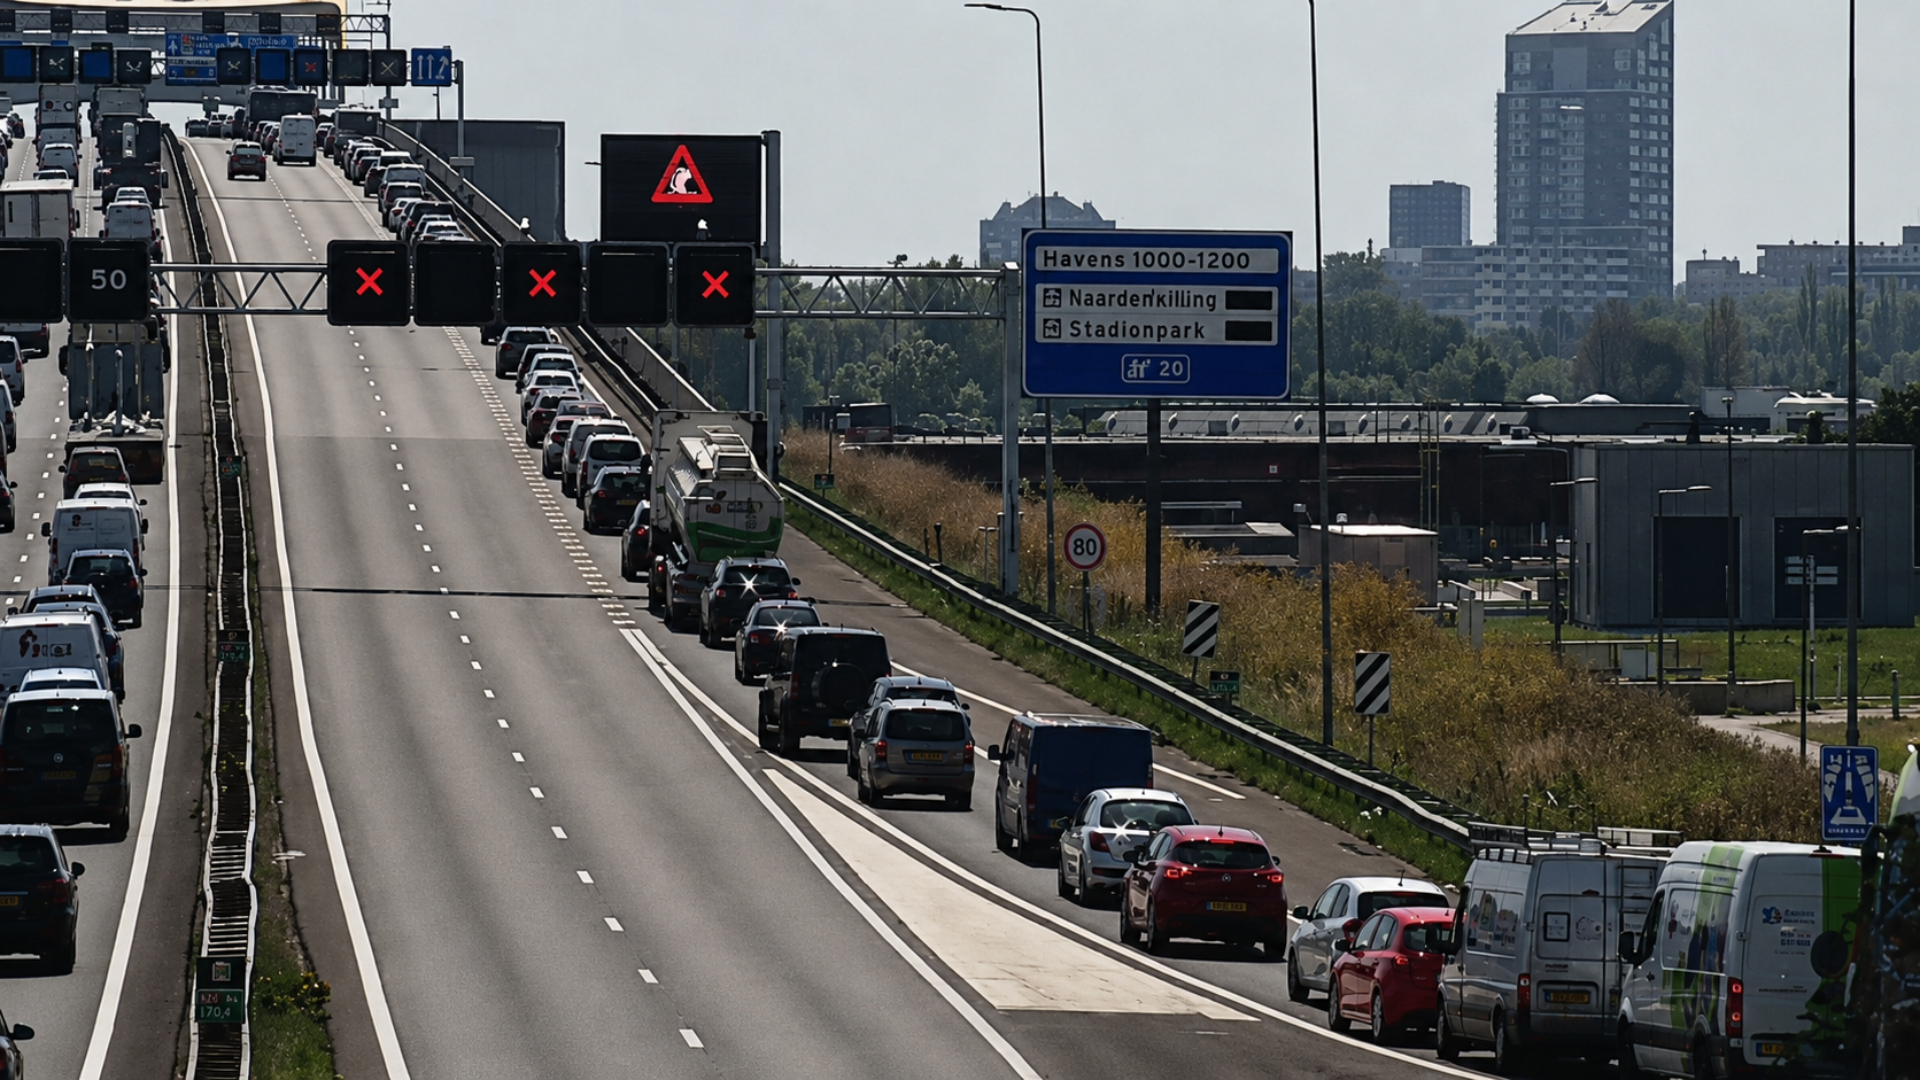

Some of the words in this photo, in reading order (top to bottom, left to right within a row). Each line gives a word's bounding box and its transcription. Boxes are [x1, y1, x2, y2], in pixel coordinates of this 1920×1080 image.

[1043, 250, 1125, 268] Havens
[1132, 251, 1250, 269] 1000-1200
[92, 269, 127, 290] 50
[1069, 320, 1205, 342] Stadionpark
[1159, 361, 1183, 376] 20
[1073, 538, 1097, 556] 80
